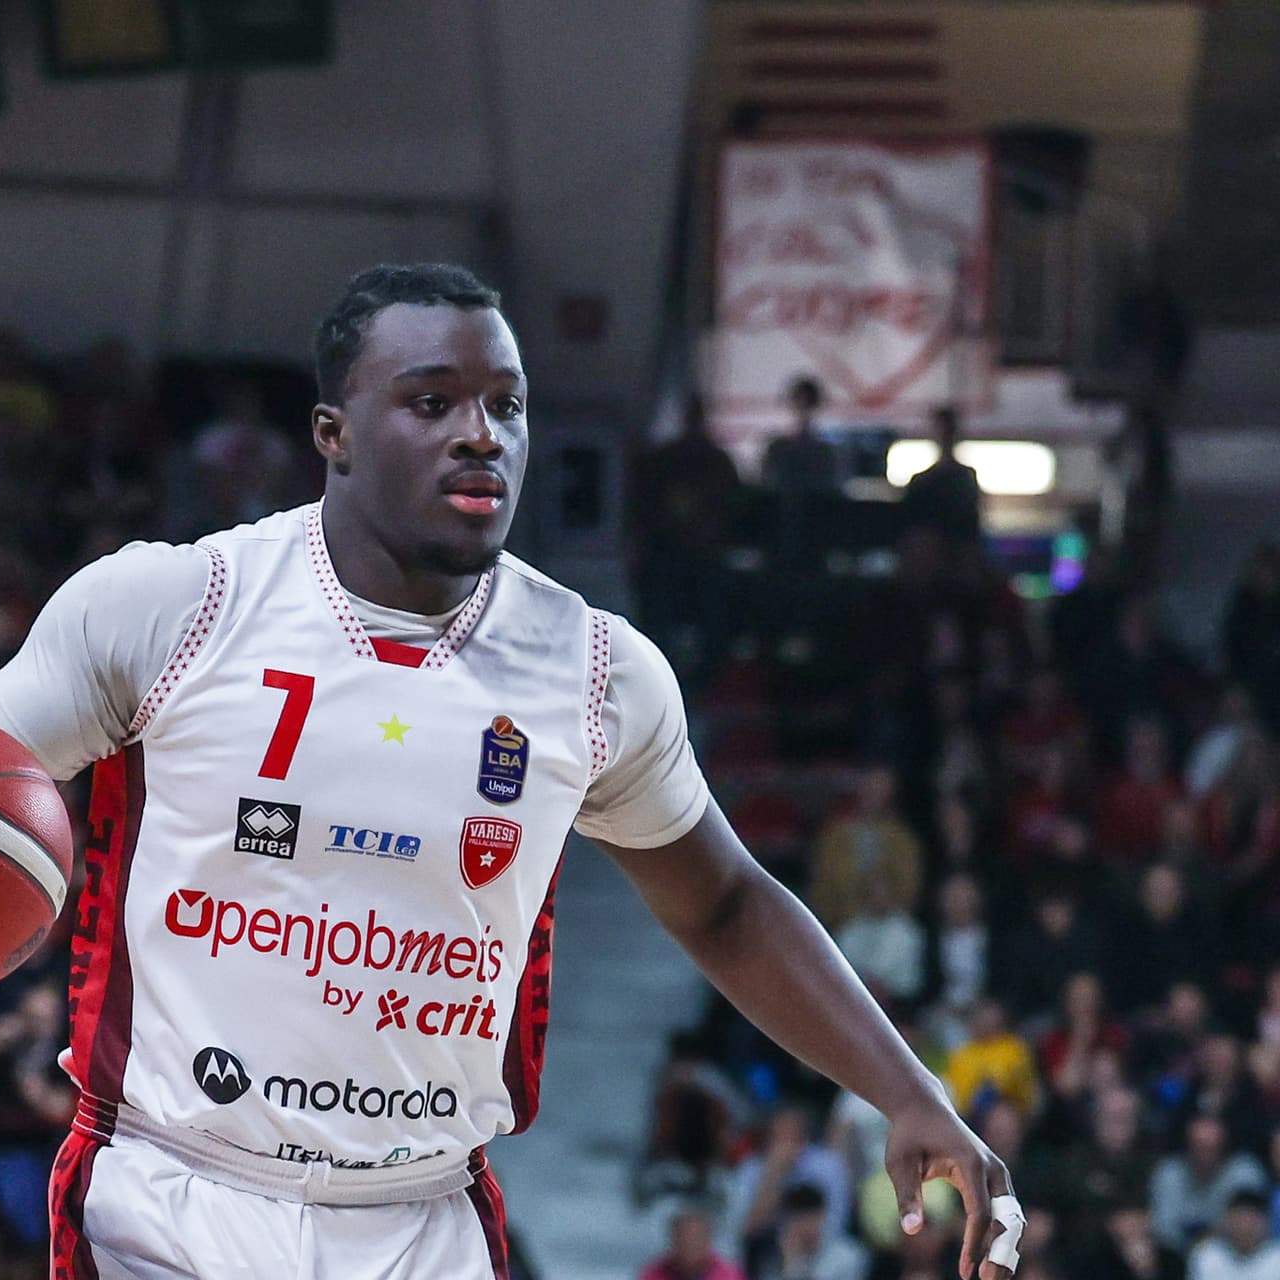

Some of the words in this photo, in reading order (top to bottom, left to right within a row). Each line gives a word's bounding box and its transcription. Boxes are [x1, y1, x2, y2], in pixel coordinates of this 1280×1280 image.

[258, 669, 315, 780] 7
[488, 750, 521, 769] LBA
[488, 779, 517, 796] Unipol
[329, 825, 395, 854] TCI
[470, 823, 516, 842] VARESE
[323, 980, 363, 1015] by
[264, 1075, 457, 1120] motorola
